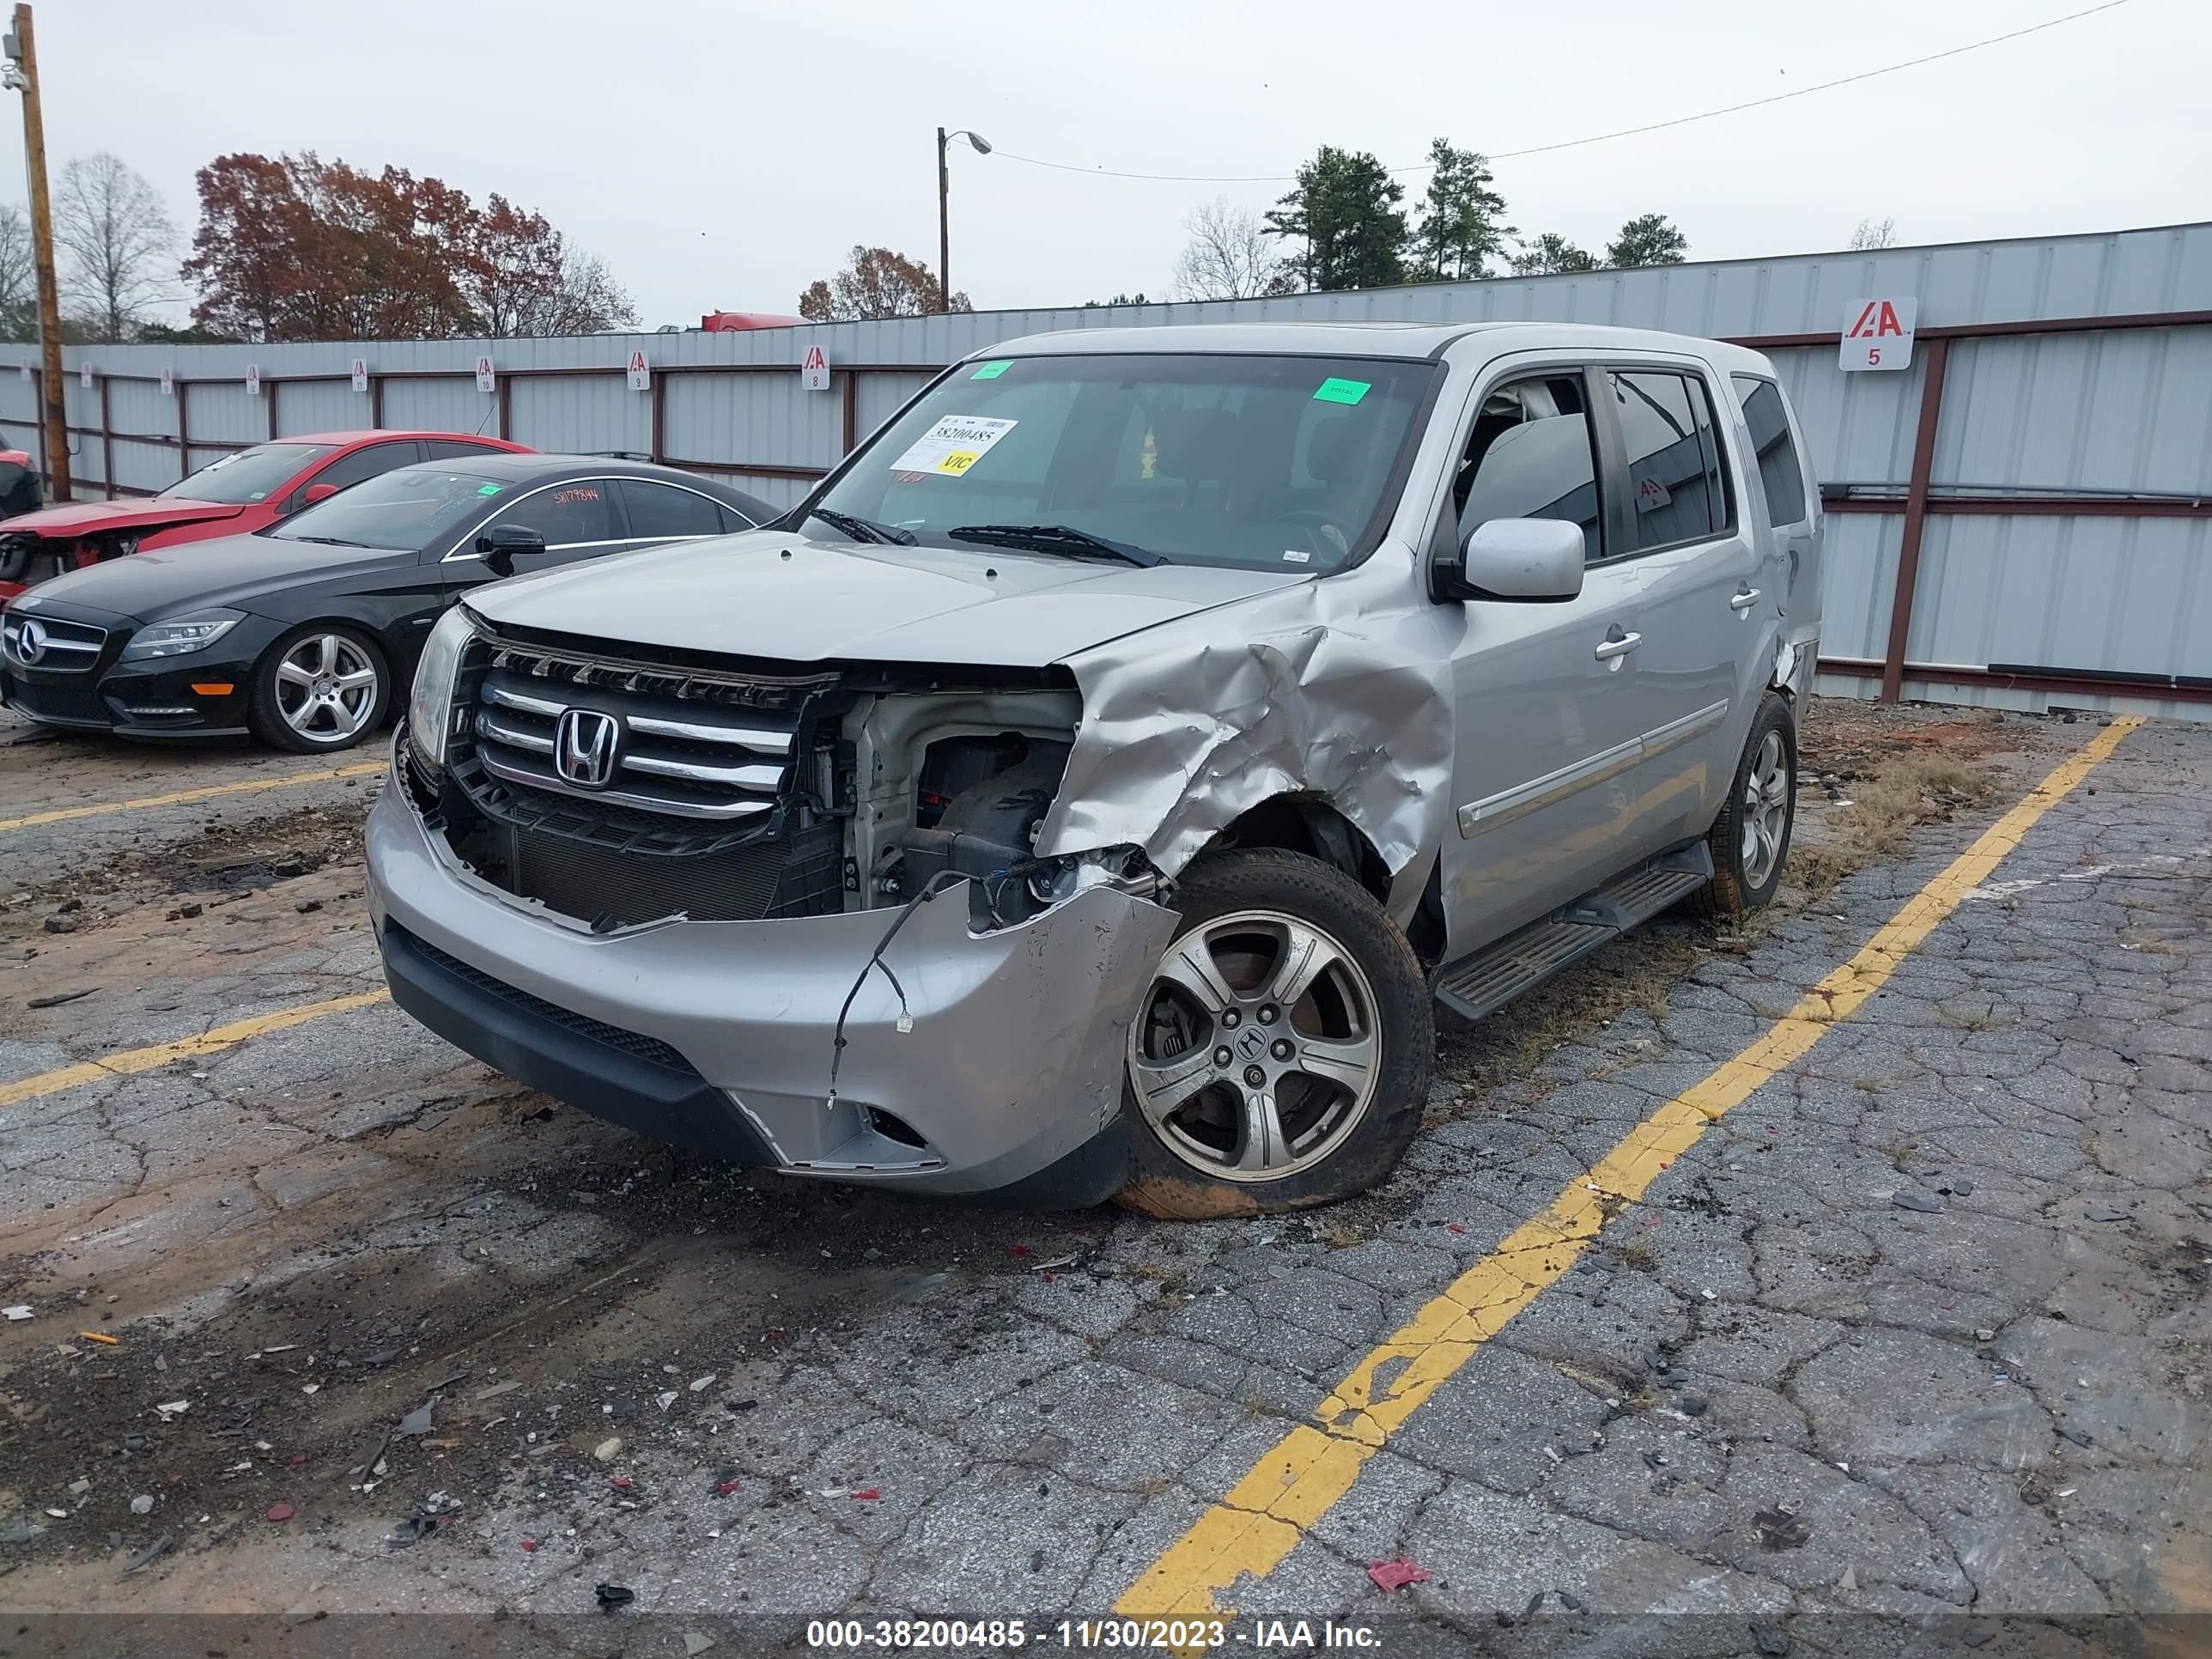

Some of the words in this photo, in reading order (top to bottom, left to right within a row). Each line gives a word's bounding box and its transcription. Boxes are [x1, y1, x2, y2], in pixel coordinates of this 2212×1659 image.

[1868, 348, 1881, 366] 5
[356, 381, 362, 390] 11
[483, 380, 489, 390] 10
[635, 378, 641, 387] 9
[812, 376, 818, 386] 8
[1330, 387, 1354, 396] TOTAL
[931, 427, 996, 442] 38200485
[944, 455, 972, 469] VIC
[552, 489, 600, 504] 38179844
